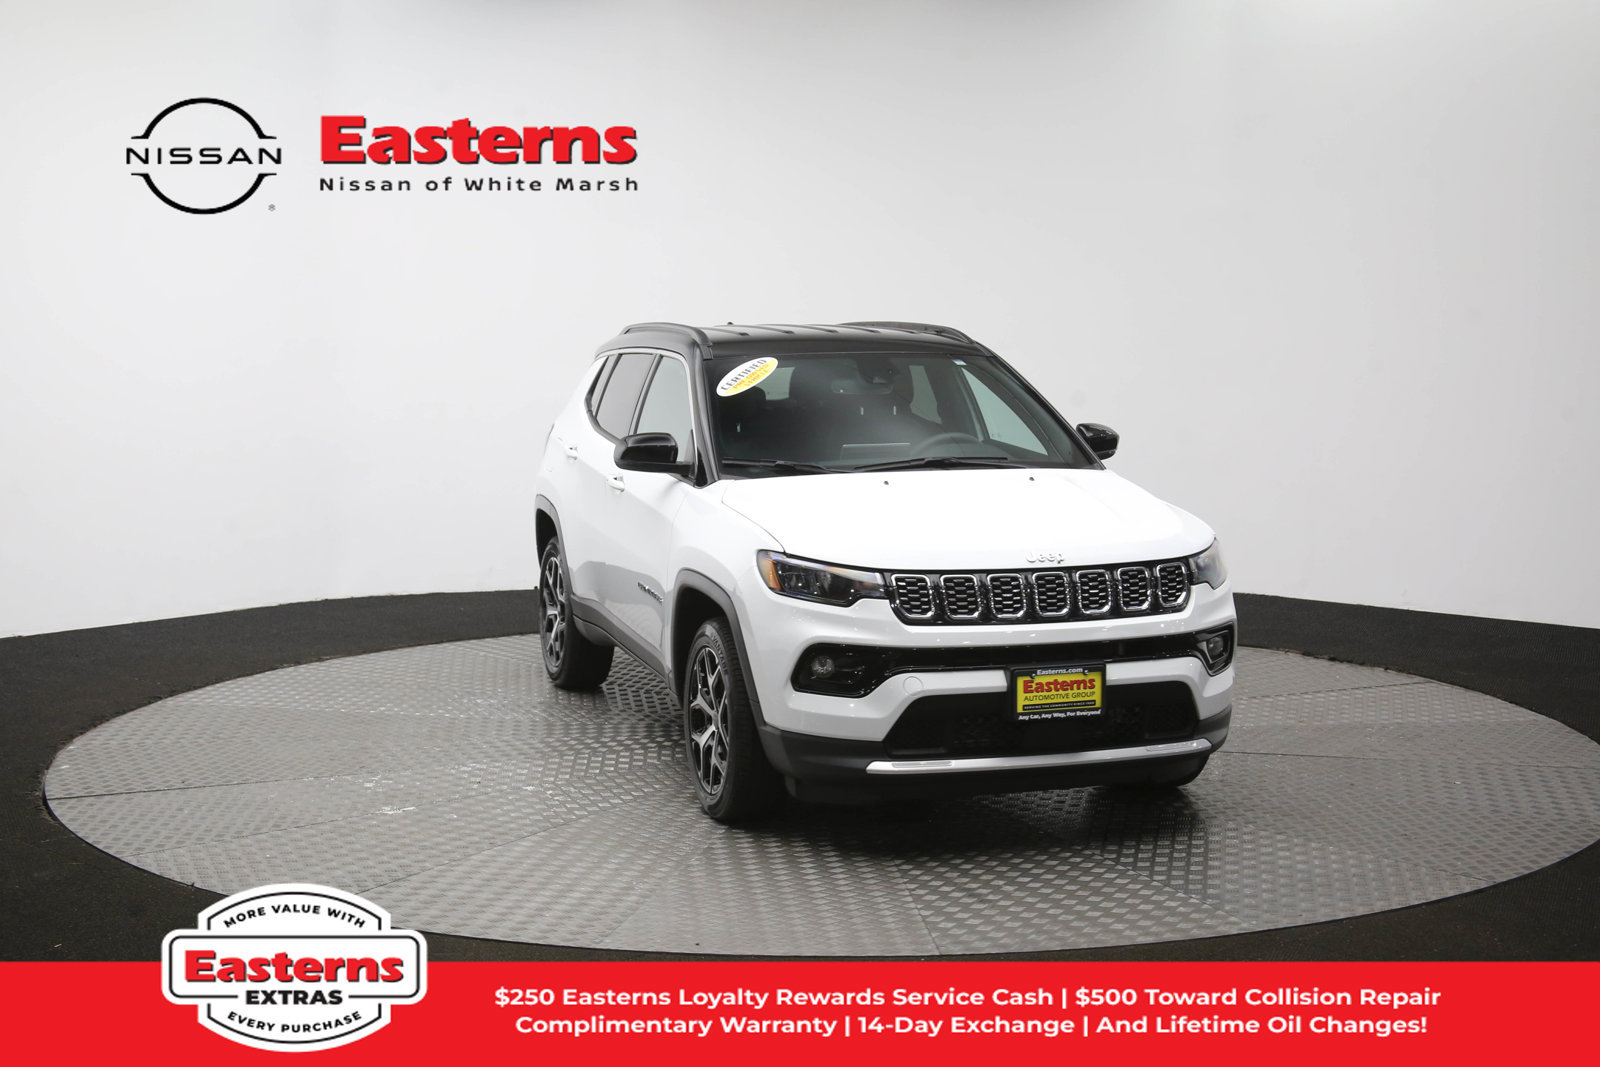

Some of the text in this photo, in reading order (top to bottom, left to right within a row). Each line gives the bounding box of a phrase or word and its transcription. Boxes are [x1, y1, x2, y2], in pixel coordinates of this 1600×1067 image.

[1026, 551, 1065, 564] Jeep
[1036, 667, 1083, 675] Easterns.com
[1023, 678, 1096, 694] Easterns
[1024, 691, 1096, 702] AUTOMOTIVE GROUP
